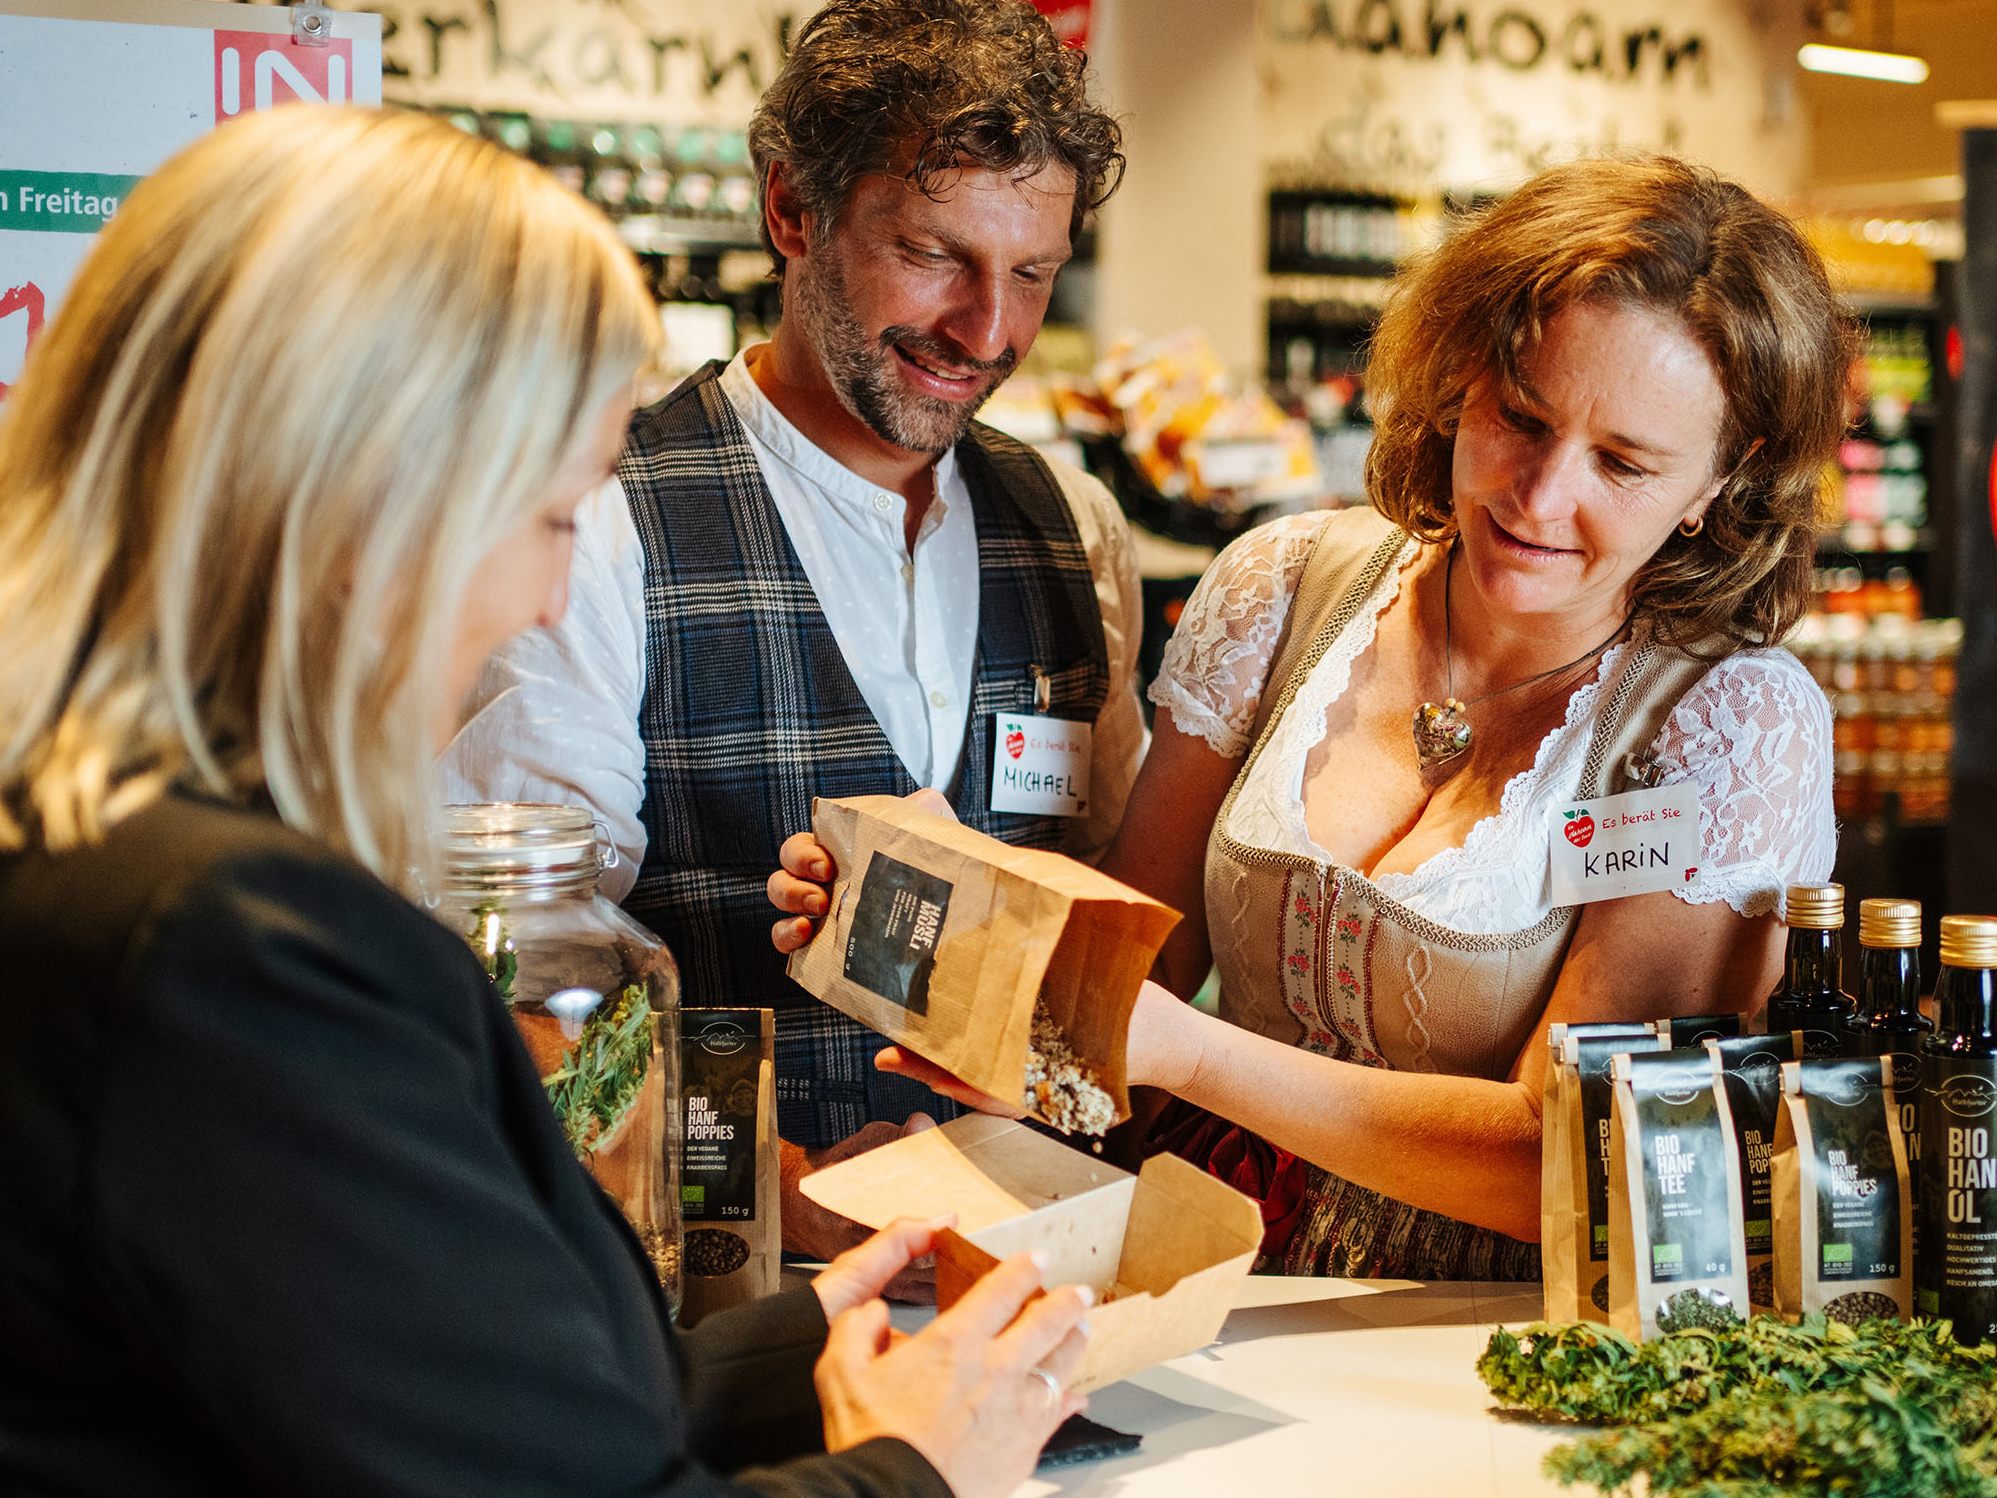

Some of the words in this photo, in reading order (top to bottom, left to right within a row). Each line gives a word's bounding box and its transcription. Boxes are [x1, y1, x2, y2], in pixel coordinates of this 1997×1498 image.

[19, 187, 118, 222] Freitag
[1004, 766, 1078, 798] MICHAEL
[1602, 818, 1617, 829] Es
[1621, 809, 1656, 826] berät
[1661, 807, 1682, 820] Sie
[922, 903, 942, 949] HANF
[689, 1097, 708, 1111] BIO
[688, 1111, 719, 1126] HANF
[687, 1125, 735, 1140] POPPIES
[1744, 1130, 1762, 1145] BIO
[1654, 1134, 1681, 1156] BIO
[1948, 1127, 1988, 1158] BIO
[1747, 1143, 1773, 1160] HANF
[1828, 1150, 1848, 1166] BIO
[1657, 1152, 1696, 1175] HANF
[1749, 1158, 1772, 1174] POP
[1831, 1164, 1859, 1182] HANF
[1948, 1158, 1997, 1188] HAN
[1658, 1174, 1687, 1196] TEE
[1832, 1179, 1878, 1197] POPPIES
[721, 1206, 740, 1215] 150
[742, 1208, 749, 1217] g
[1705, 1263, 1717, 1273] 40
[1719, 1263, 1727, 1273] g
[1869, 1263, 1887, 1273] 150
[1889, 1264, 1896, 1274] g
[1989, 1322, 1997, 1334] 2
